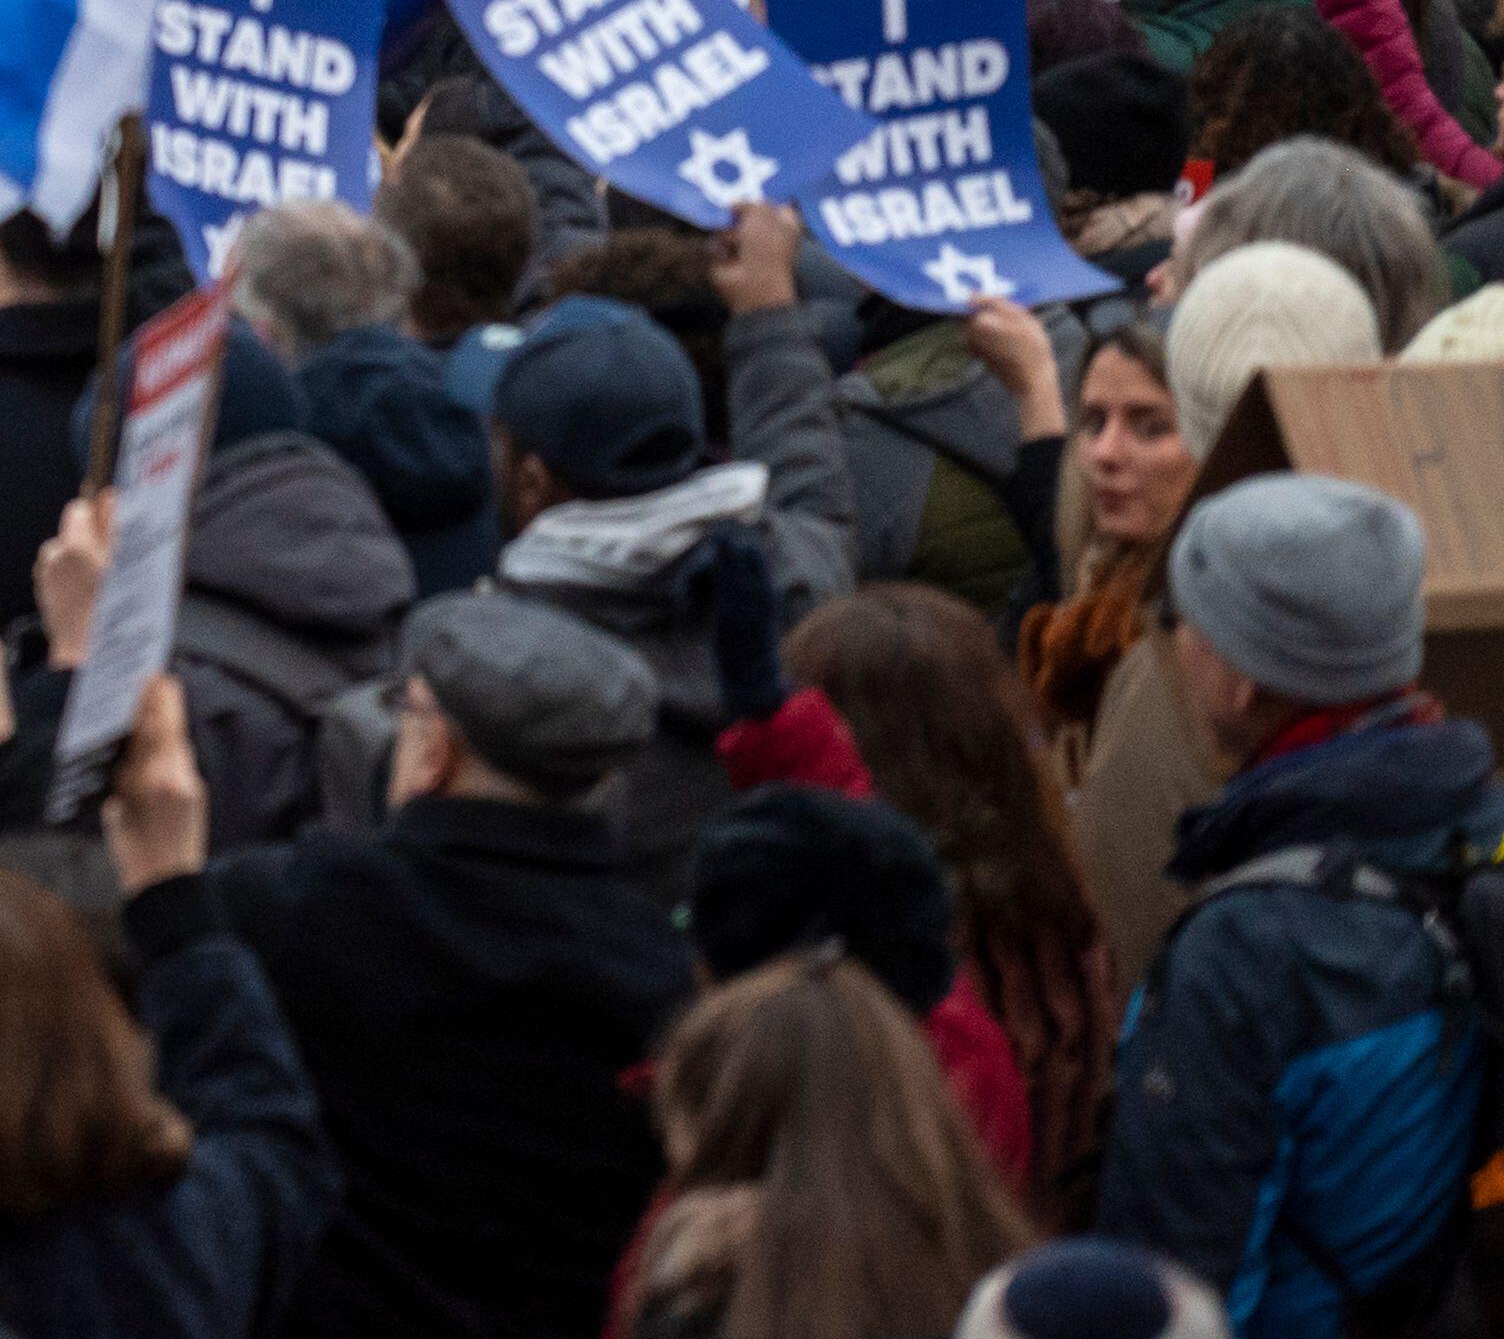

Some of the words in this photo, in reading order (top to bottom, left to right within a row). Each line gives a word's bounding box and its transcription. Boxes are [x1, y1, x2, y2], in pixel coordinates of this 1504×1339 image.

[168, 62, 330, 155] WITH
[562, 29, 772, 167] ISRAEL
[833, 106, 994, 185] WITH
[825, 170, 1031, 249] ISRAEL
